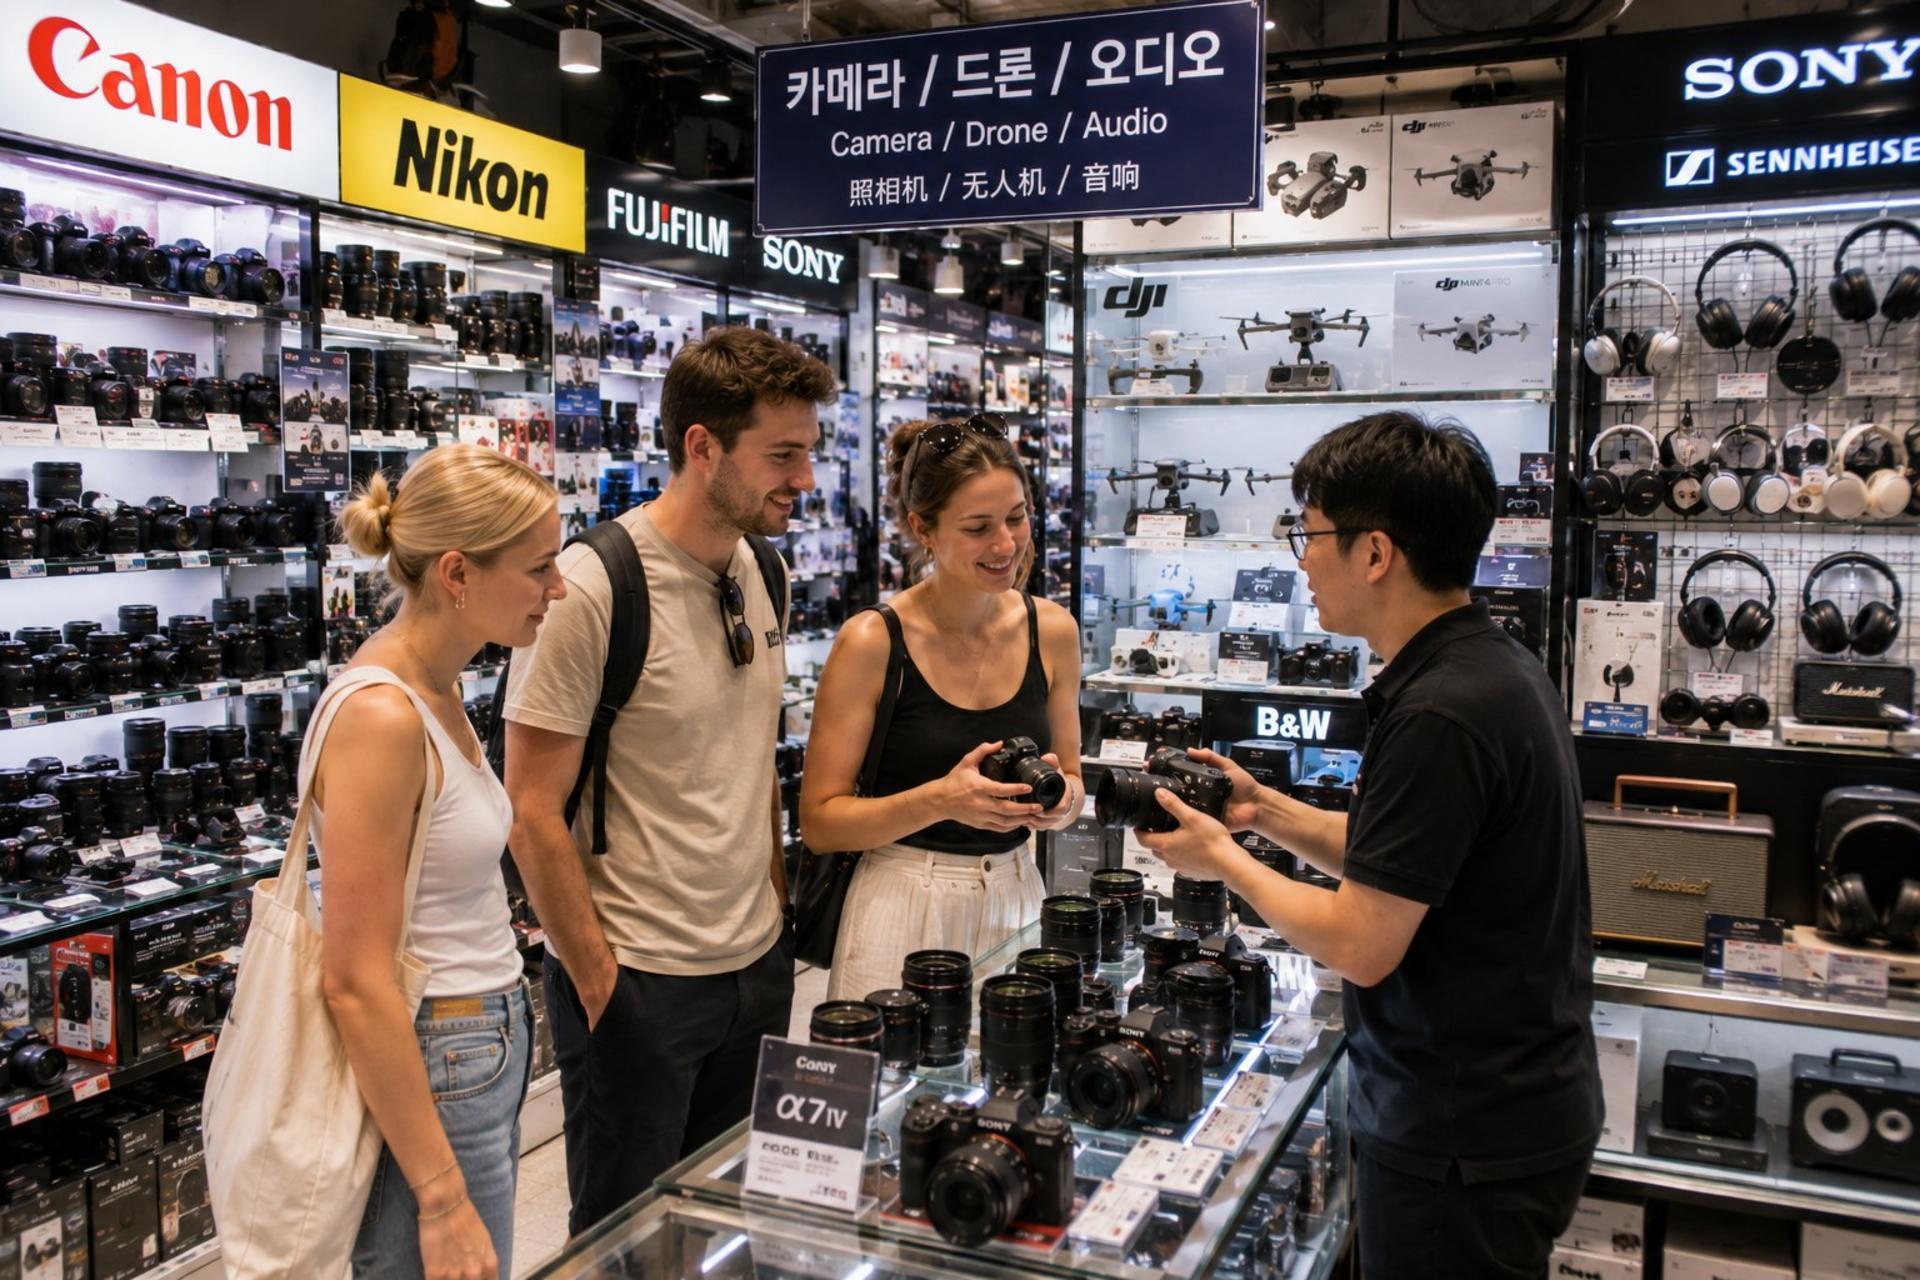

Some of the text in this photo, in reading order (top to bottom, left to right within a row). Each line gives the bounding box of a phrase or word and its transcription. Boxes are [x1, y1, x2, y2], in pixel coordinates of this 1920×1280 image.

[28, 16, 292, 150] Canon
[786, 58, 906, 116] 카메라
[952, 46, 1036, 99] 드론
[1086, 30, 1225, 86] 오디오
[1684, 36, 1920, 100] SONY
[830, 130, 932, 157] Camera
[966, 121, 1048, 147] Drone
[1083, 107, 1168, 139] Audio
[393, 118, 549, 220] Nikon
[850, 174, 928, 207] 照相机
[962, 167, 1046, 200] 无人机
[1082, 160, 1140, 193] 音响
[763, 235, 844, 284] SONY
[1257, 705, 1331, 740] B&W
